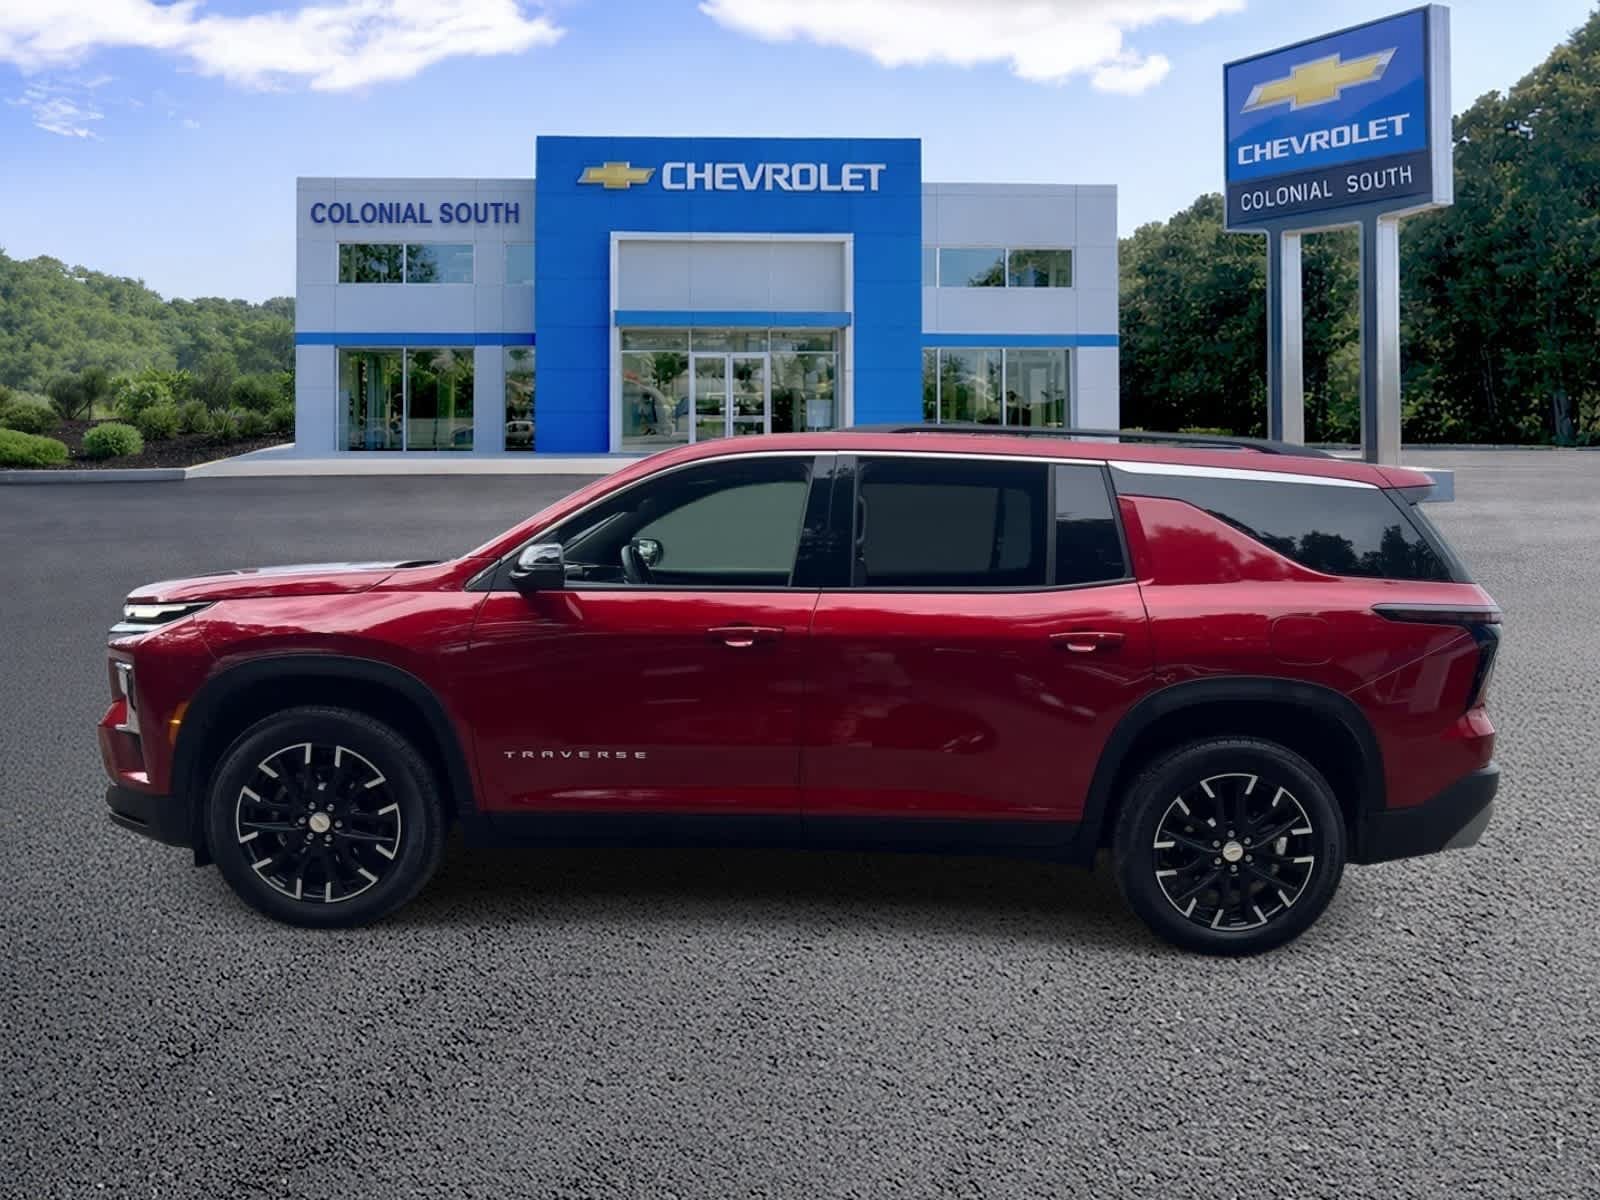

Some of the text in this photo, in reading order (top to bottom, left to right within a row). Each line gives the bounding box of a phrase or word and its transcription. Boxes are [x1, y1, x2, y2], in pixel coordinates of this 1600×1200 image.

[1238, 113, 1410, 165] CHEVROLET
[662, 162, 887, 192] CHEVROLET
[1241, 165, 1413, 211] COLONIAL SOUTH
[310, 201, 520, 225] COLONIAL SOUTH
[504, 750, 647, 759] TRAVERSE
